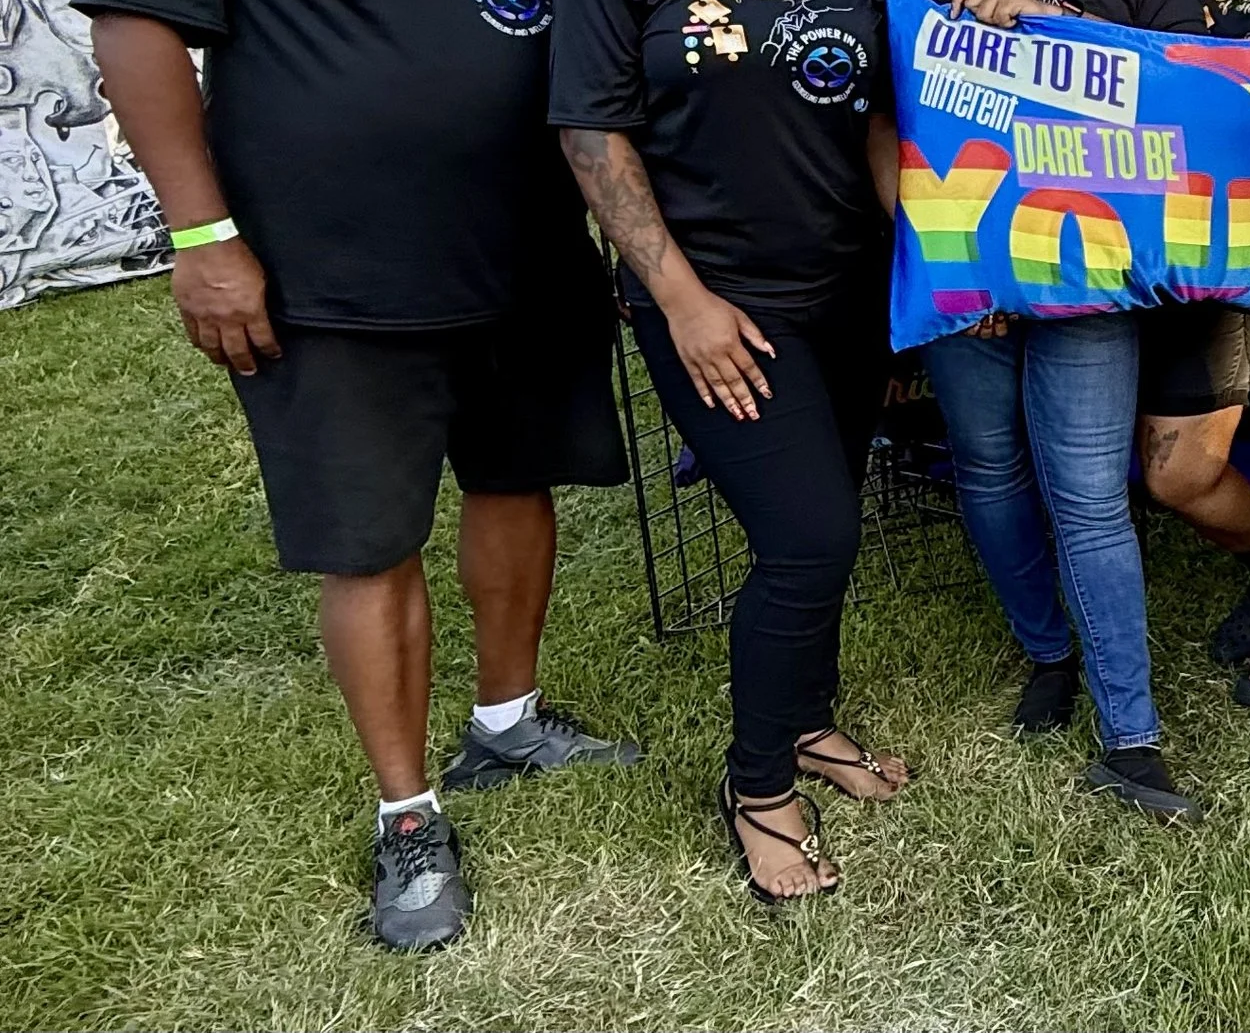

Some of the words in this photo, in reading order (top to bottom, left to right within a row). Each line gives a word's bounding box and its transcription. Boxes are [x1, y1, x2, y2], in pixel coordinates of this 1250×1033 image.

[1218, 0, 1233, 15] of
[786, 40, 802, 62] THE
[800, 27, 842, 46] POWER
[842, 33, 857, 47] IN
[855, 44, 868, 68] YOU
[926, 17, 1020, 79] DARE
[1030, 38, 1075, 92] TO
[1083, 49, 1129, 109] BE
[919, 64, 1019, 135] different
[1013, 121, 1089, 178] DARE
[1096, 127, 1137, 180] TO
[1141, 128, 1181, 182] BE
